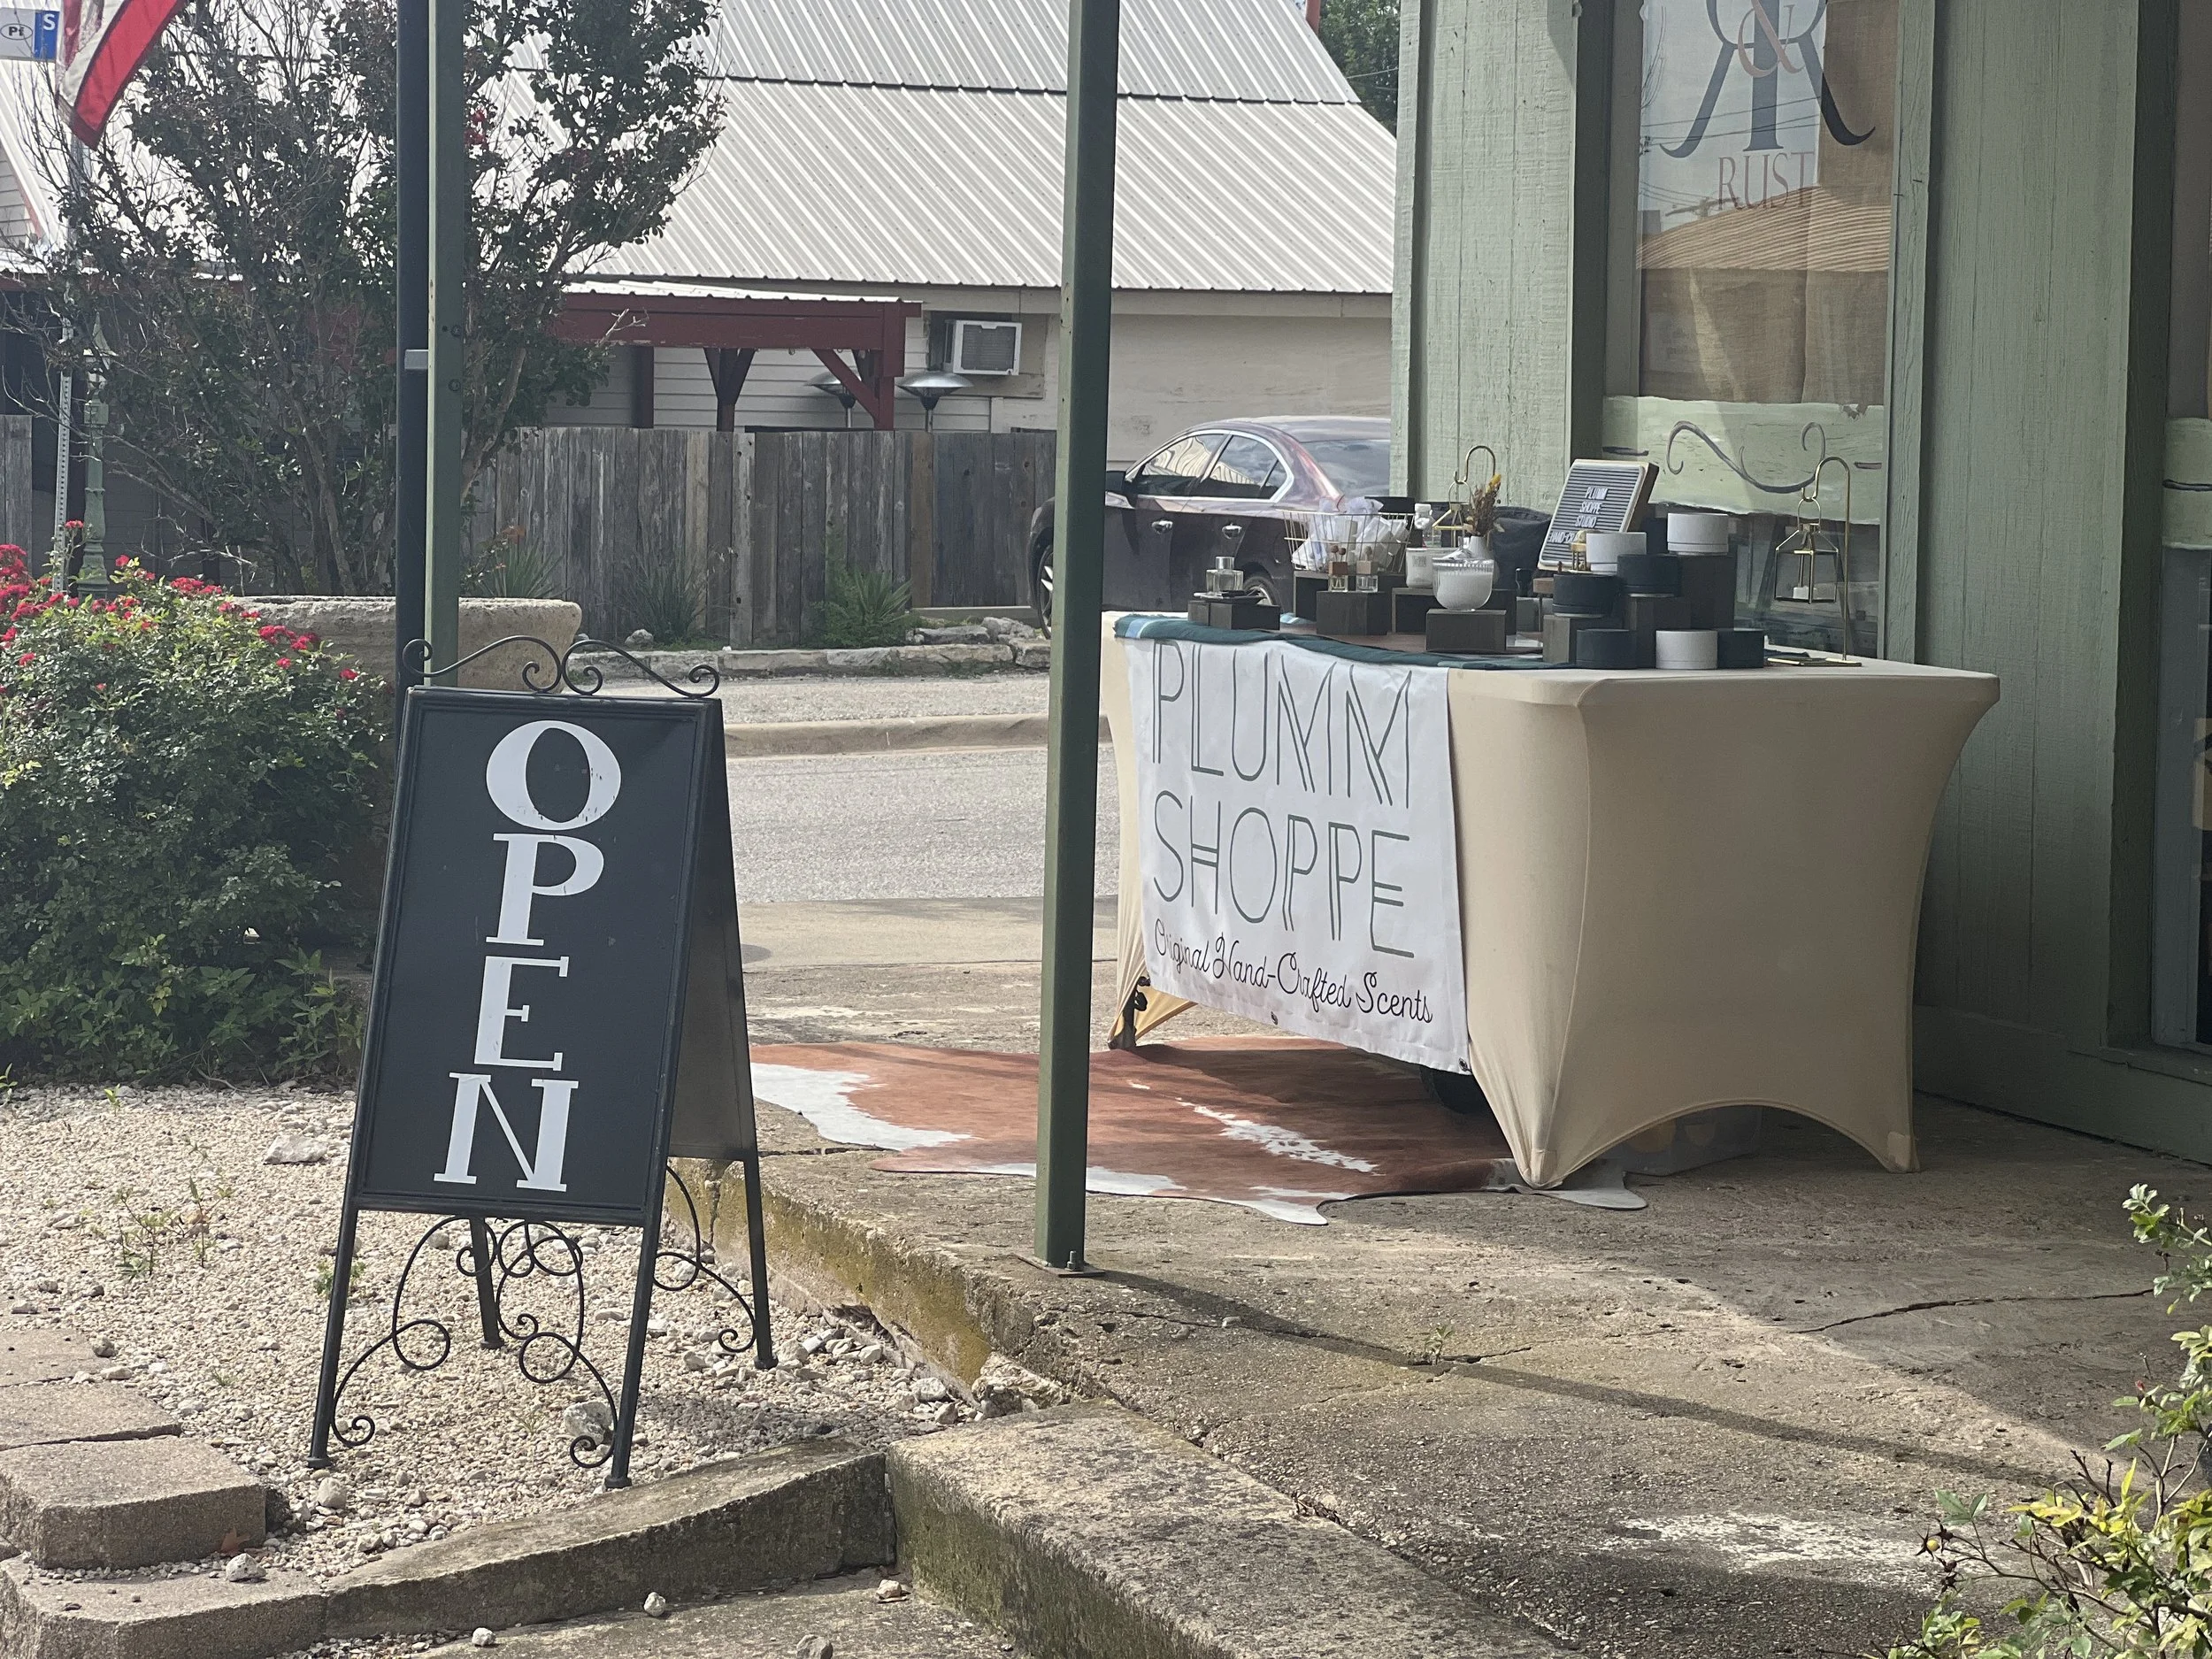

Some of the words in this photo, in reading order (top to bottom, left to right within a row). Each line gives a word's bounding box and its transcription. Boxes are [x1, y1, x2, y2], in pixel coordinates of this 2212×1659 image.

[1718, 151, 1815, 211] RUST
[1575, 515, 1597, 527] STUDIO
[1579, 501, 1602, 514] SHOPPE
[1585, 487, 1608, 500] PLUMM
[1152, 641, 1412, 809] PLUMM
[1153, 790, 1415, 958] SHOPPE
[434, 719, 622, 1193] OPEN
[1155, 918, 1210, 974] Original
[1212, 932, 1352, 1012] Hand-Crafted
[1356, 972, 1433, 1024] Scents
